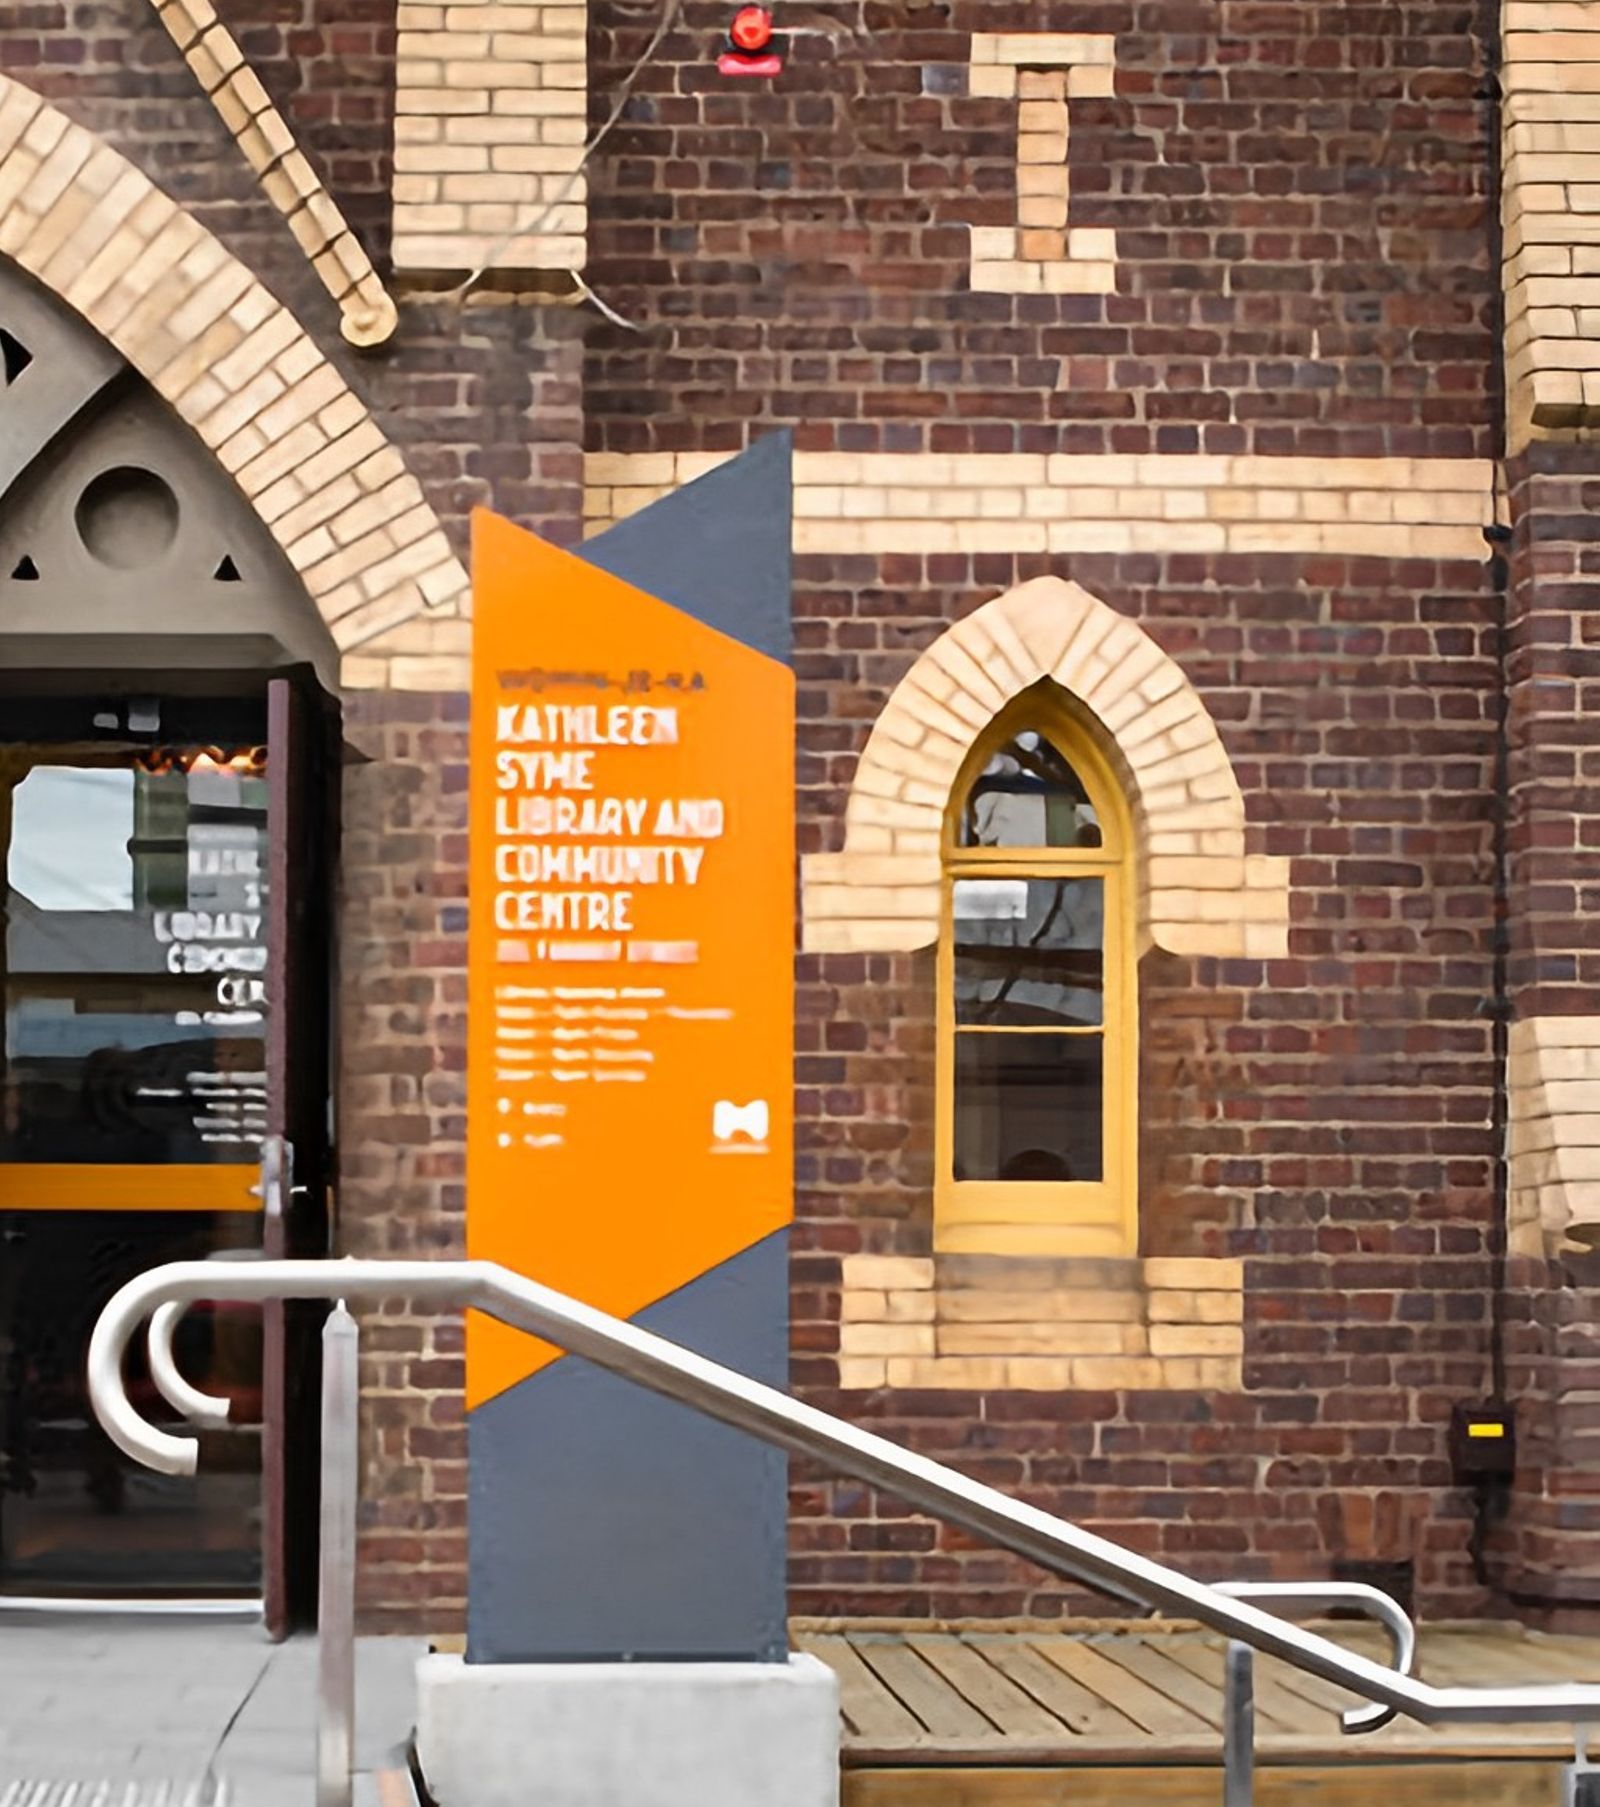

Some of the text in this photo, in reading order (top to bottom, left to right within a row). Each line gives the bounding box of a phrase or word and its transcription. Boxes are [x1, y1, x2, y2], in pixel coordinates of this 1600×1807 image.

[496, 704, 679, 746] KATHLEEN
[496, 750, 595, 790] SYME
[496, 797, 724, 838] LIBRARY AND
[495, 844, 704, 885] COMMUNITY
[495, 890, 633, 931] CENTRE
